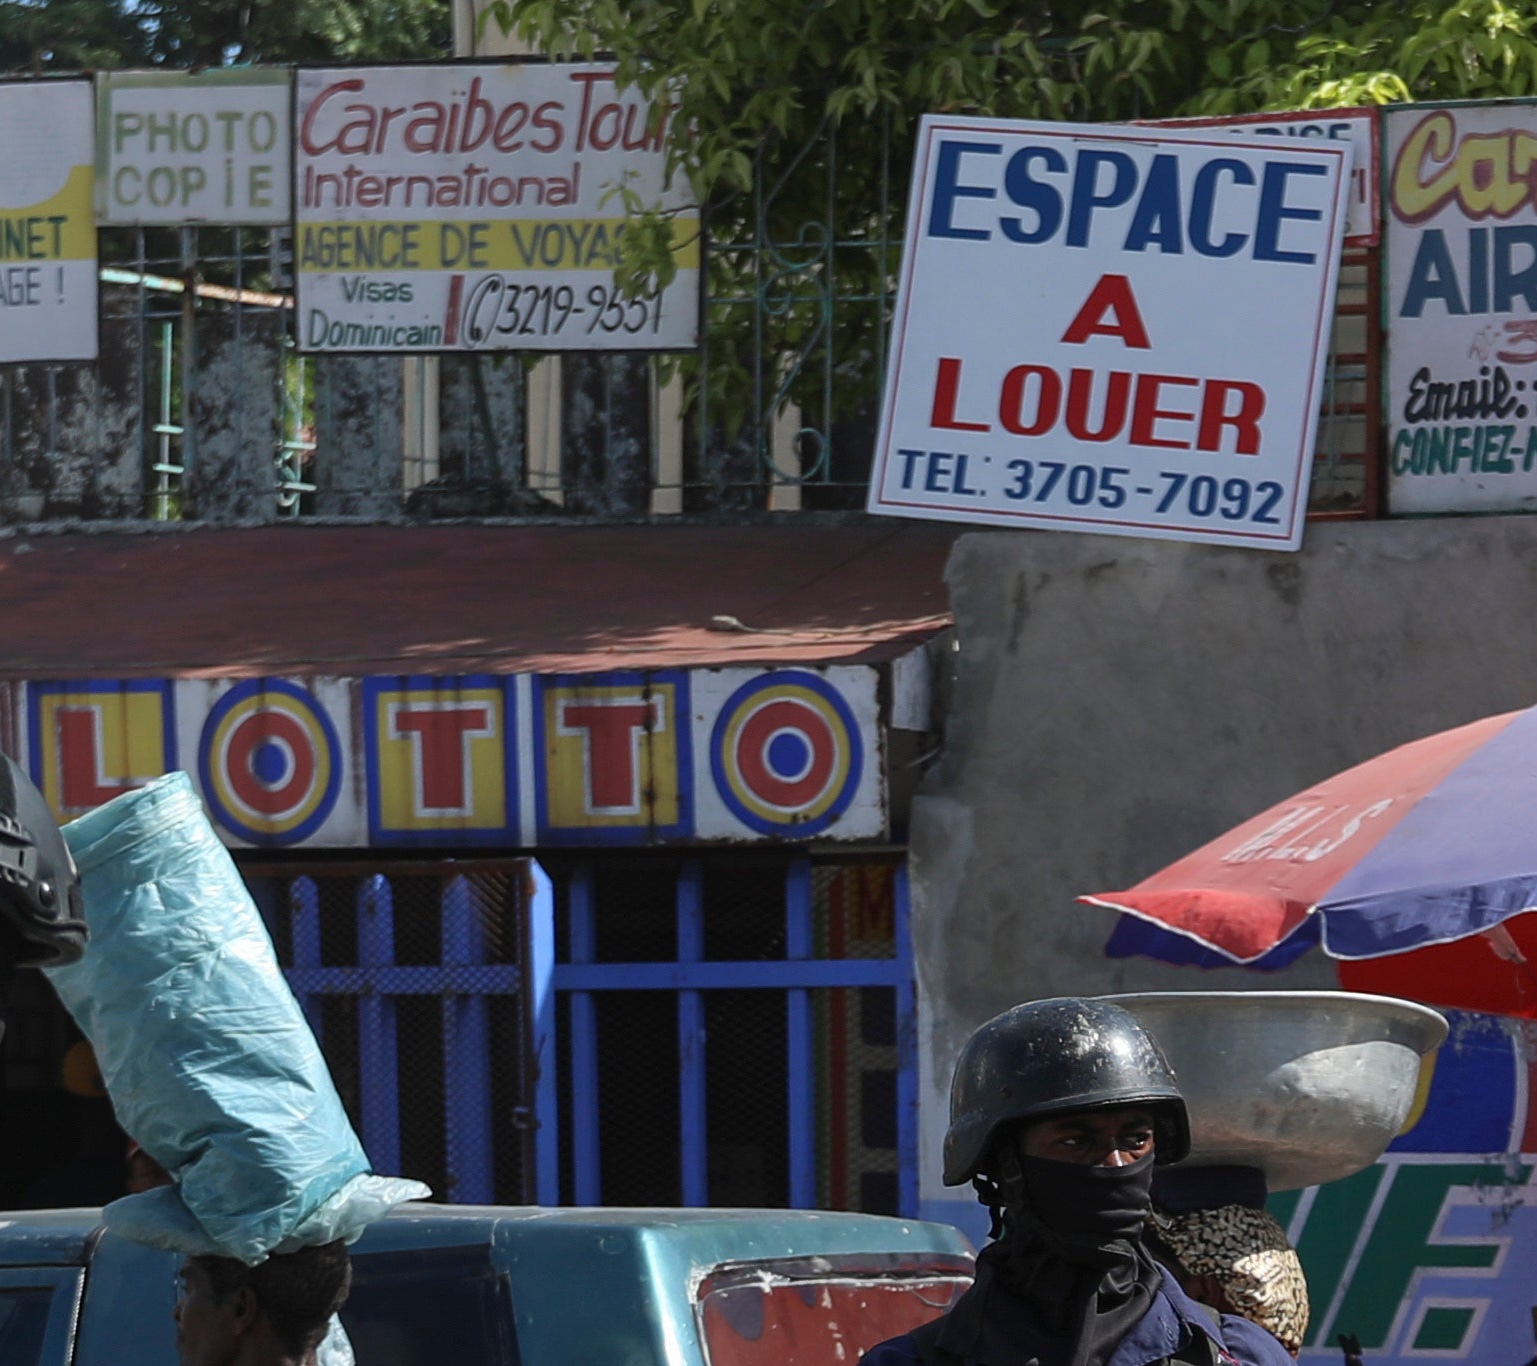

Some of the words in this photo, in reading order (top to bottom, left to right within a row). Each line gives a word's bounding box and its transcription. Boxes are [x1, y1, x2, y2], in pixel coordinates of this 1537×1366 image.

[114, 110, 278, 153] PHOTO
[300, 78, 566, 154] Caraïbes
[304, 162, 581, 209] International
[926, 139, 1329, 265] ESPACE
[301, 224, 420, 270] AGENCE
[439, 223, 491, 267] DE
[340, 276, 415, 303] Visas
[1059, 272, 1153, 349] A
[307, 309, 442, 348] Dominicain
[929, 356, 1268, 457] LOUER
[1003, 457, 1285, 525] 3705-7092
[38, 670, 862, 844] LOTTO
